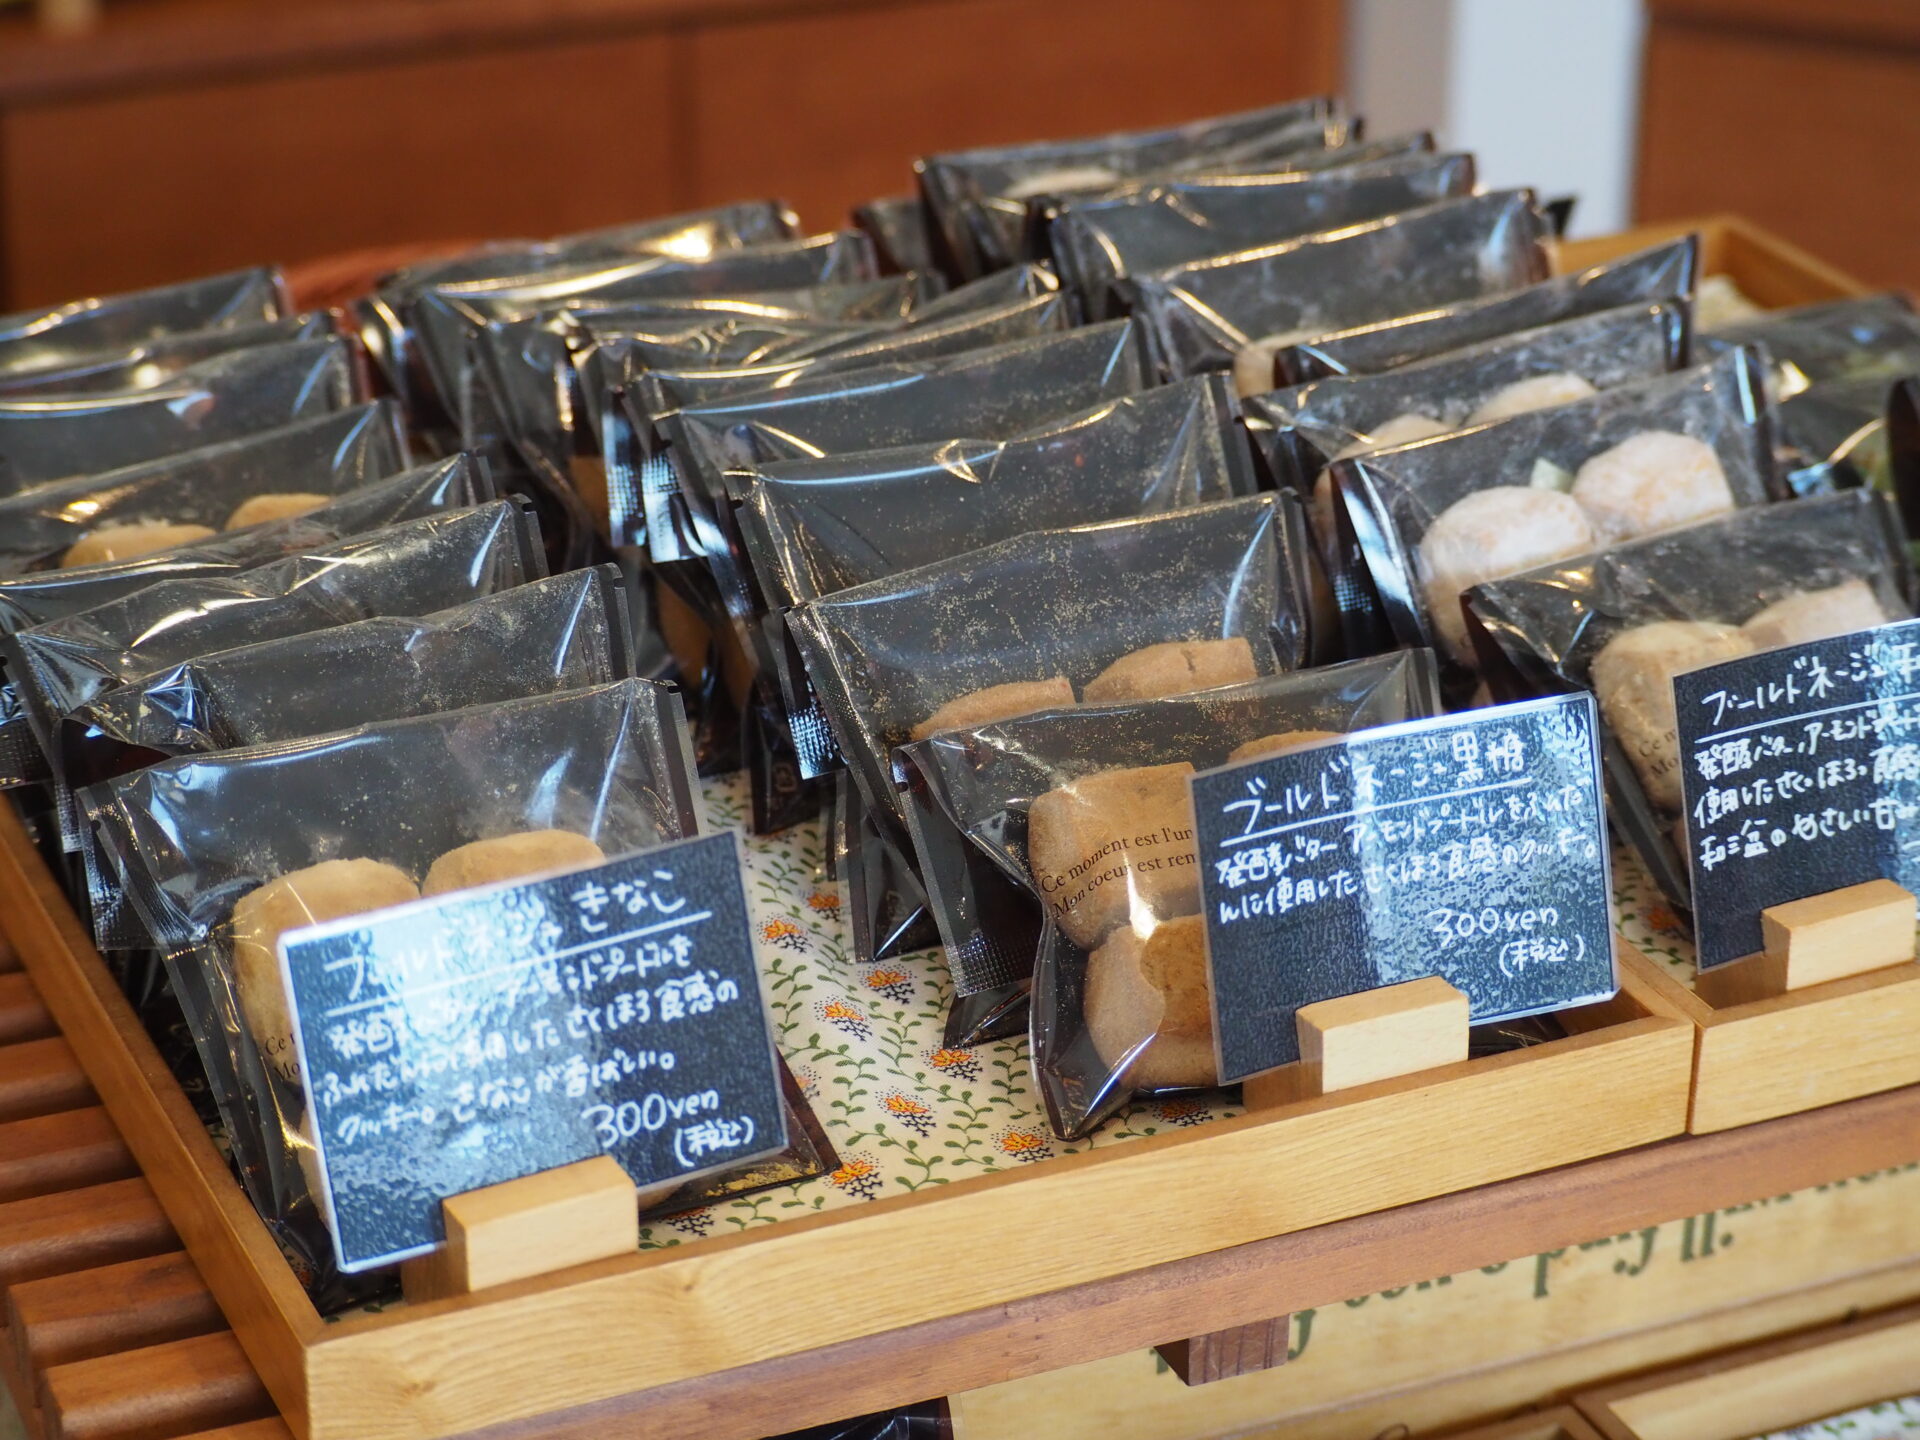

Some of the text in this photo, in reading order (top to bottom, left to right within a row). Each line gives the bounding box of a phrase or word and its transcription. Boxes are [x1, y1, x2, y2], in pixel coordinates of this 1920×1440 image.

[1041, 874, 1066, 893] Ce
[1068, 837, 1130, 881] moment
[1135, 833, 1160, 847] est
[1053, 889, 1085, 918] Mon
[1137, 858, 1162, 873] est
